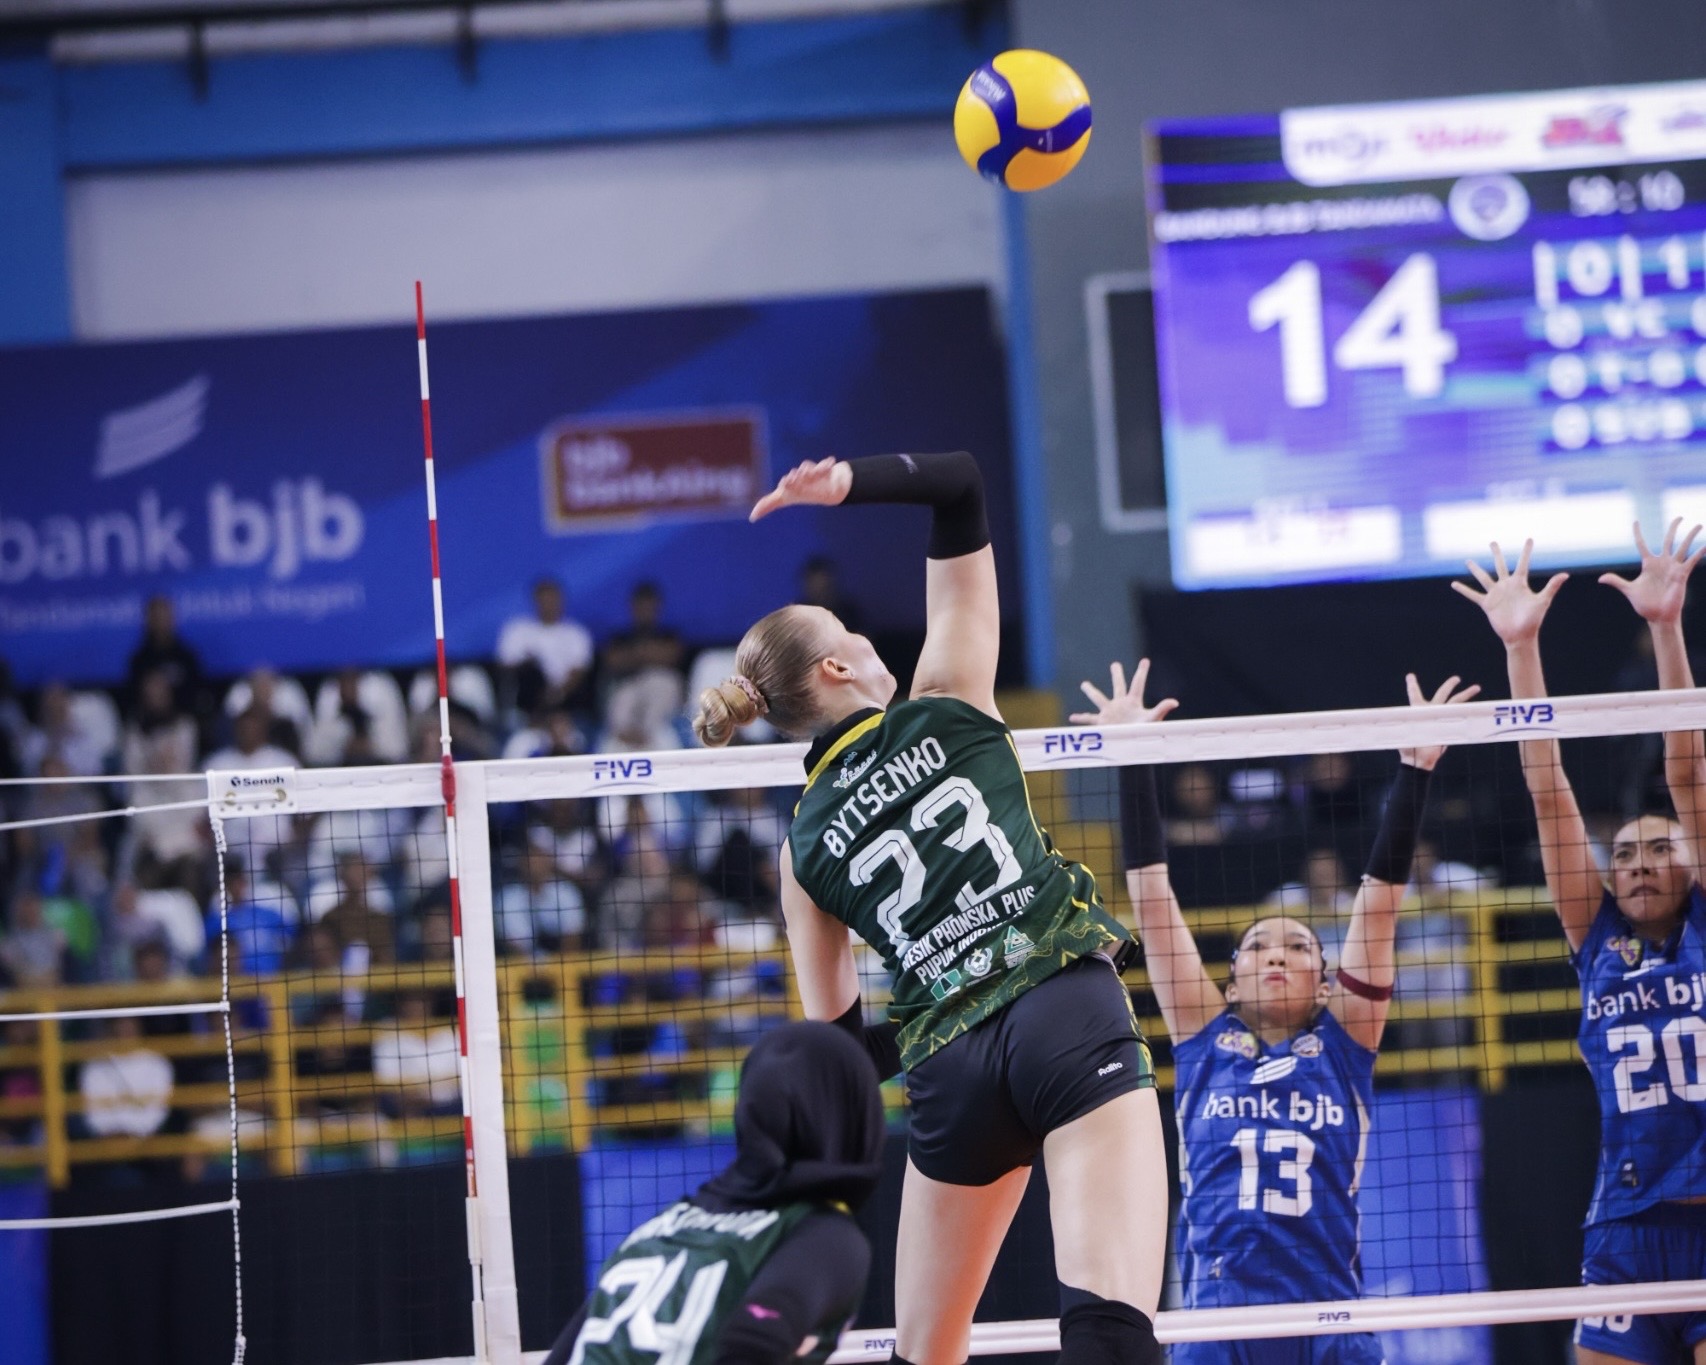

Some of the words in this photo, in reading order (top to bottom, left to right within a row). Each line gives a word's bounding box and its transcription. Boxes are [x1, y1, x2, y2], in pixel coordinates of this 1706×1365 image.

[1249, 252, 1458, 408] 14
[208, 474, 366, 579] bjb
[1494, 704, 1553, 725] FIVB
[1045, 732, 1102, 753] FIVB
[243, 775, 284, 787] Senoh
[594, 759, 652, 779] FIVB
[823, 736, 947, 858] BYTSENKO
[849, 776, 1023, 959] 23
[914, 944, 957, 986] PUPUK
[1587, 982, 1661, 1020] bank
[1665, 972, 1706, 1012] bj
[1606, 1016, 1706, 1113] 20
[1202, 1088, 1281, 1120] bank
[1289, 1091, 1345, 1131] bjb
[1230, 1128, 1316, 1217] 13
[1318, 1311, 1351, 1322] FIVB
